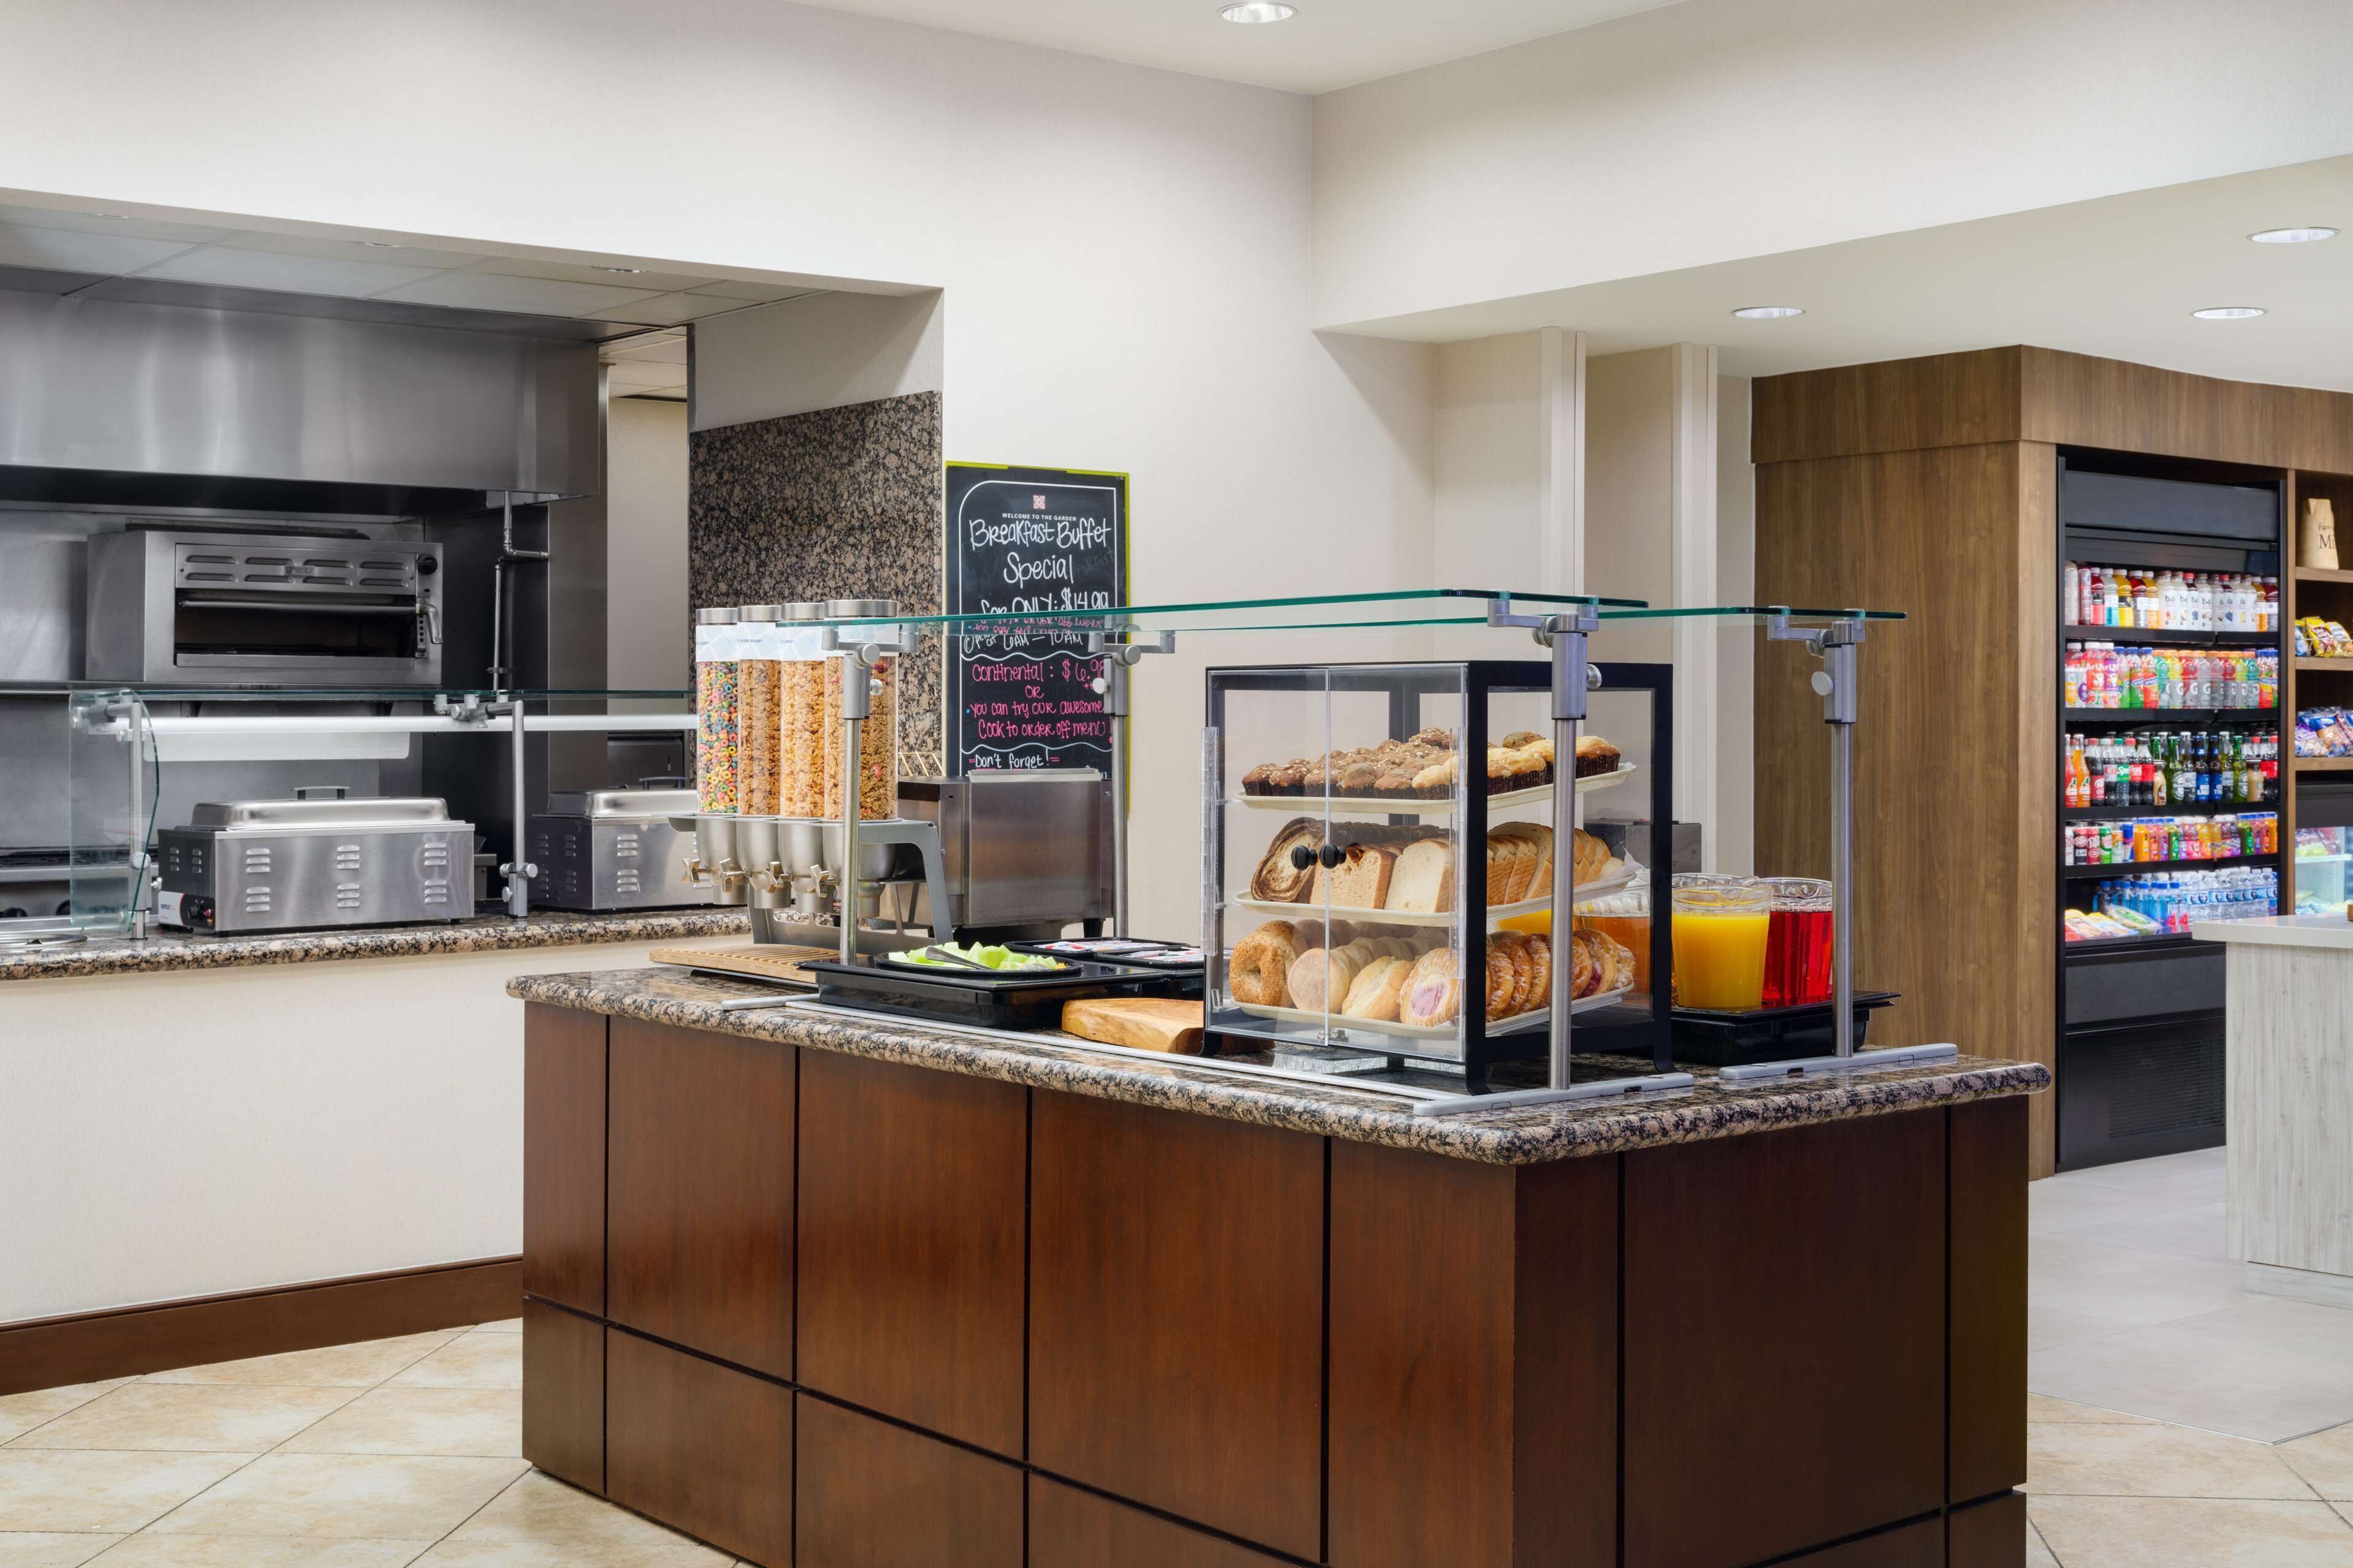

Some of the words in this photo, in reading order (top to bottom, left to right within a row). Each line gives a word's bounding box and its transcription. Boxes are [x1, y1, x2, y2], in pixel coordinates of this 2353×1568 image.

[1057, 517, 1112, 550] Buffet
[1003, 551, 1074, 589] Special
[973, 662, 1043, 681] Continental
[970, 703, 987, 718] you
[991, 703, 1008, 716] can
[1012, 701, 1029, 719] try
[1060, 700, 1104, 714] awesome
[978, 719, 1005, 739] Cook
[1006, 721, 1018, 737] to
[1056, 720, 1071, 738] off
[975, 753, 1002, 768] Don't
